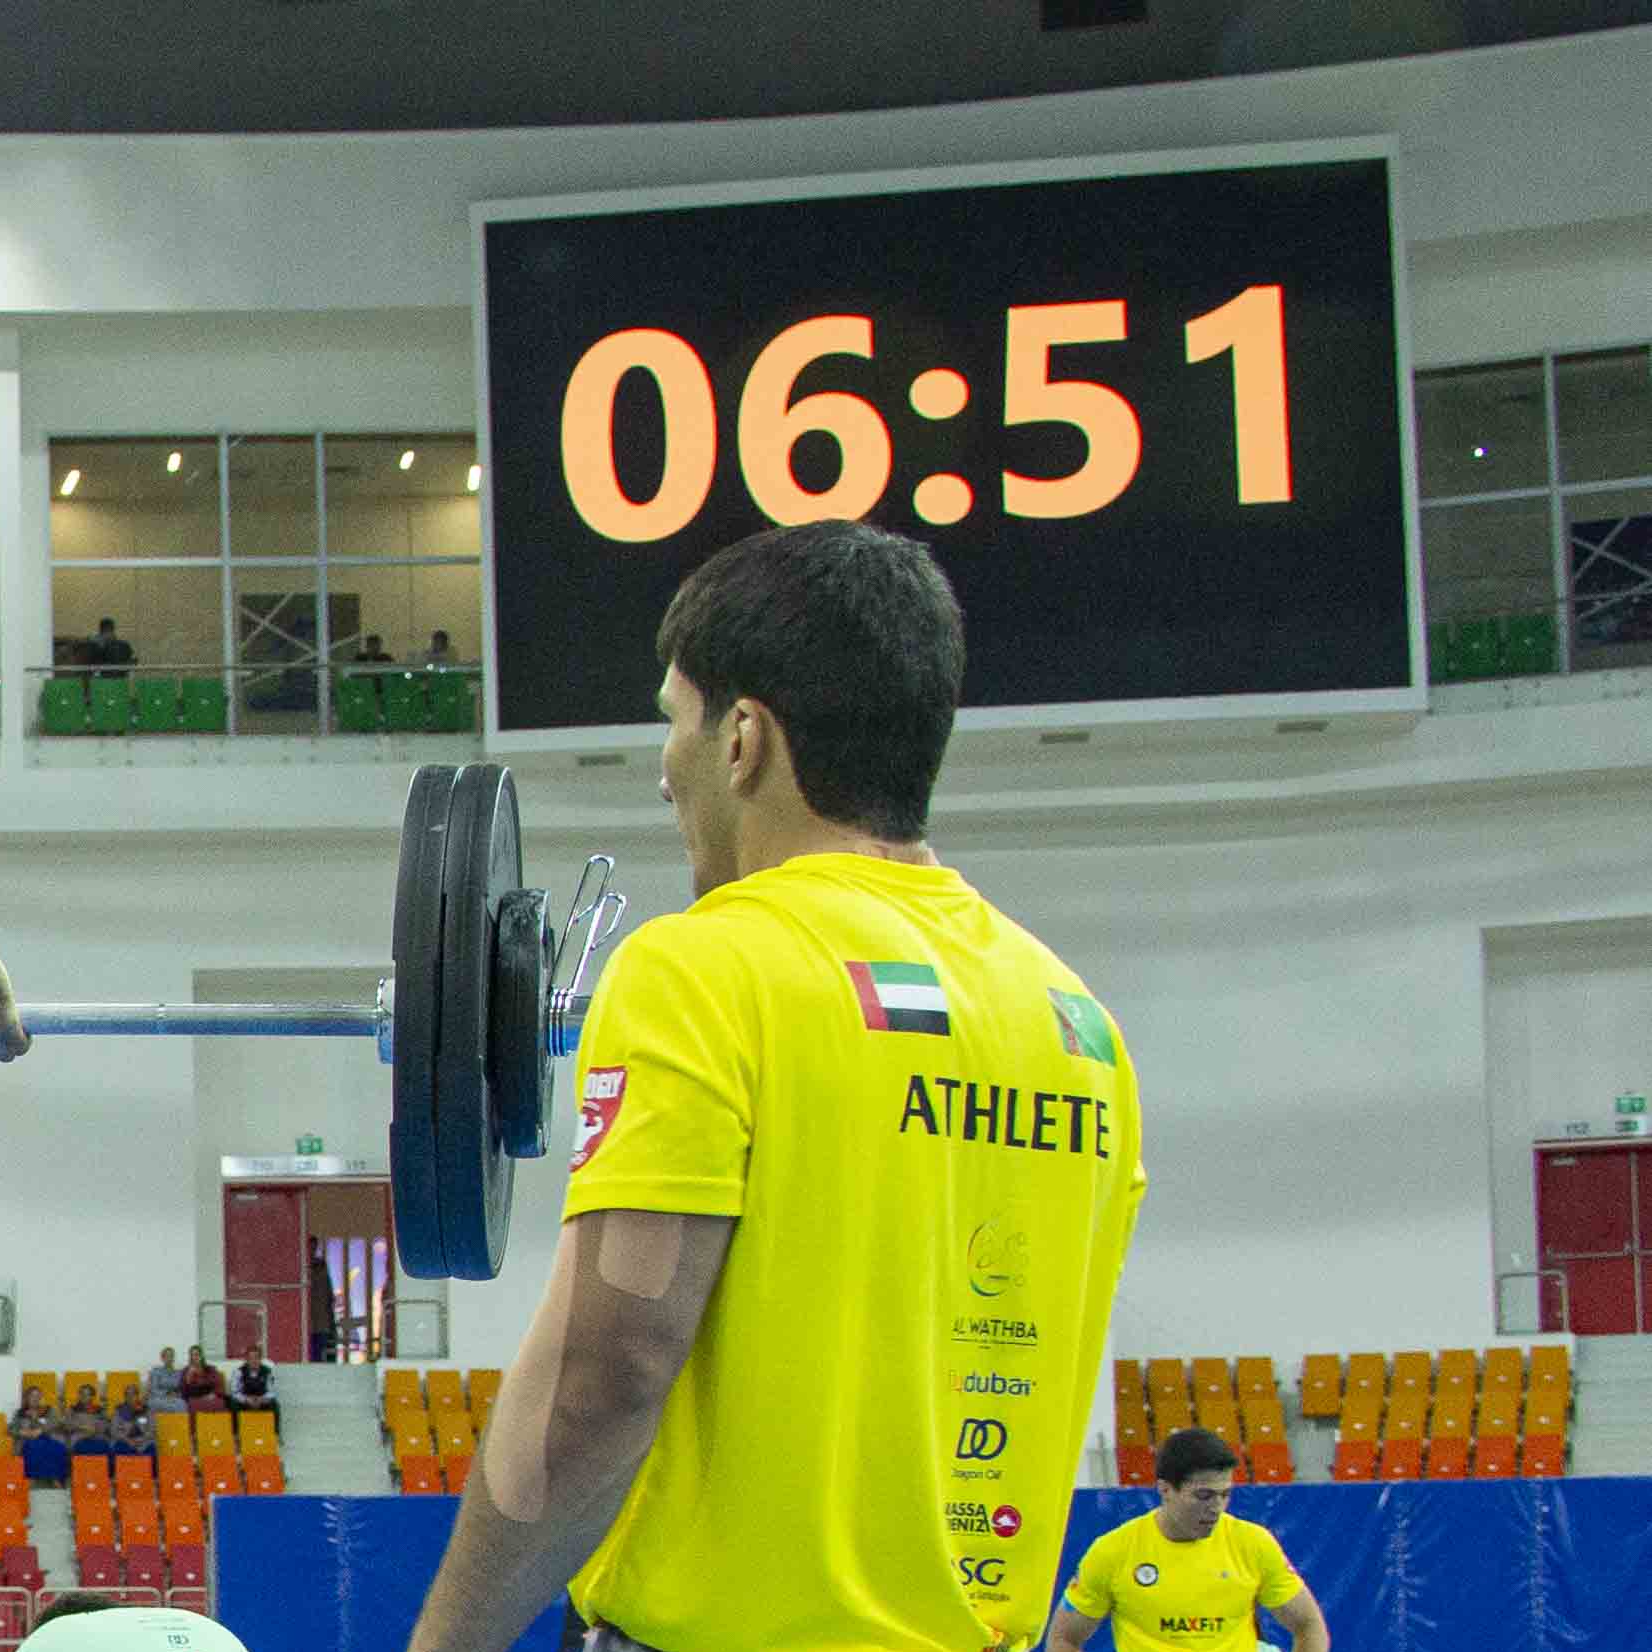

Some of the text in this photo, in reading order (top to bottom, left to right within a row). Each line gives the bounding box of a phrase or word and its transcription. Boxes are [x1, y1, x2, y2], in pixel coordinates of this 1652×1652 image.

[560, 284, 1292, 543] 06:51
[899, 1074, 1109, 1159] ATHLETE
[969, 1318, 1038, 1339] WATHBA
